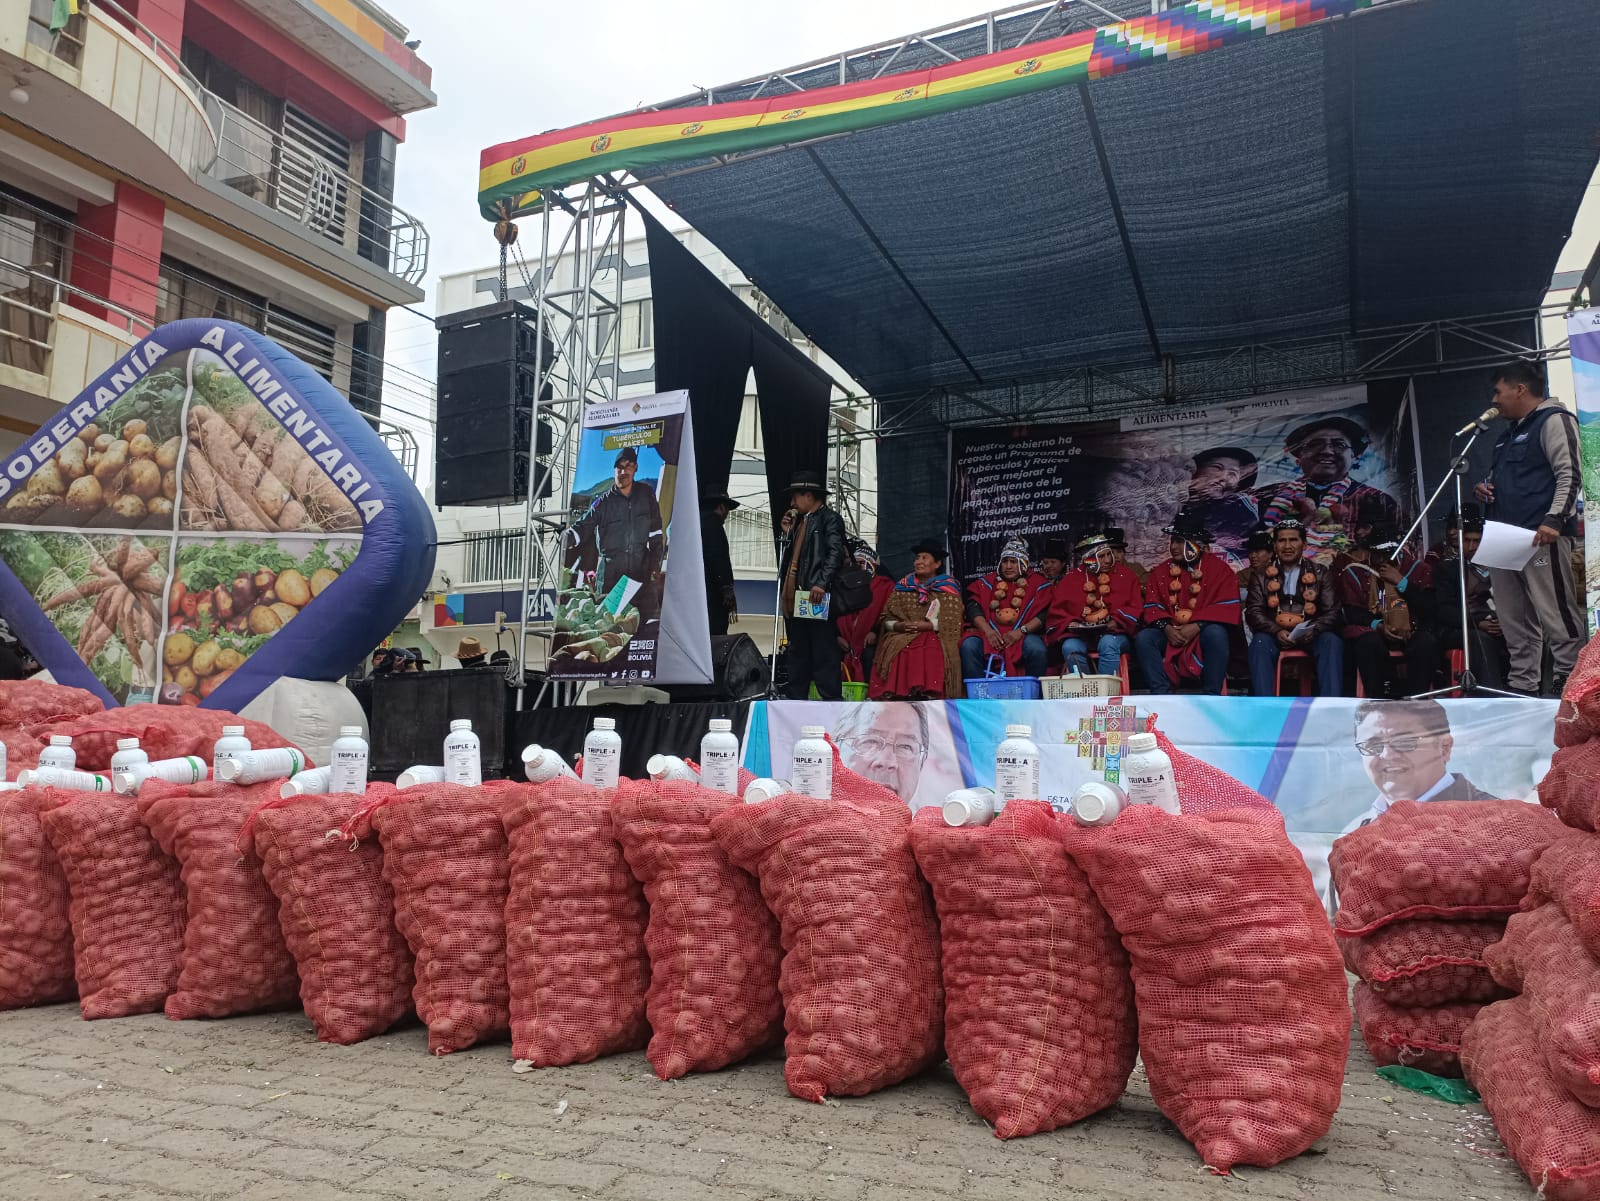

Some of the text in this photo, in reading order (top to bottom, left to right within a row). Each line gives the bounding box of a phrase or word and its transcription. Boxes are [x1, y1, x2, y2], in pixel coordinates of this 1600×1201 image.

[0, 339, 168, 497] SOBERANÍA
[200, 326, 384, 524] ALIMENTARIA
[1132, 410, 1208, 426] ALIMENTARIA
[965, 436, 1072, 454] Nuestro gobierno ha
[958, 446, 1082, 465] creado un Programa de
[967, 457, 1070, 474] Tubérculos y Raíces
[976, 466, 1057, 486] para mejorar el
[970, 476, 1062, 496] rendimiento de la
[962, 487, 1070, 510] papa, no solo otorga
[979, 502, 1051, 516] insumos si no
[1032, 512, 1058, 523] para
[960, 522, 1070, 543] mejorar rendimiento
[1048, 796, 1072, 804] ESTA
